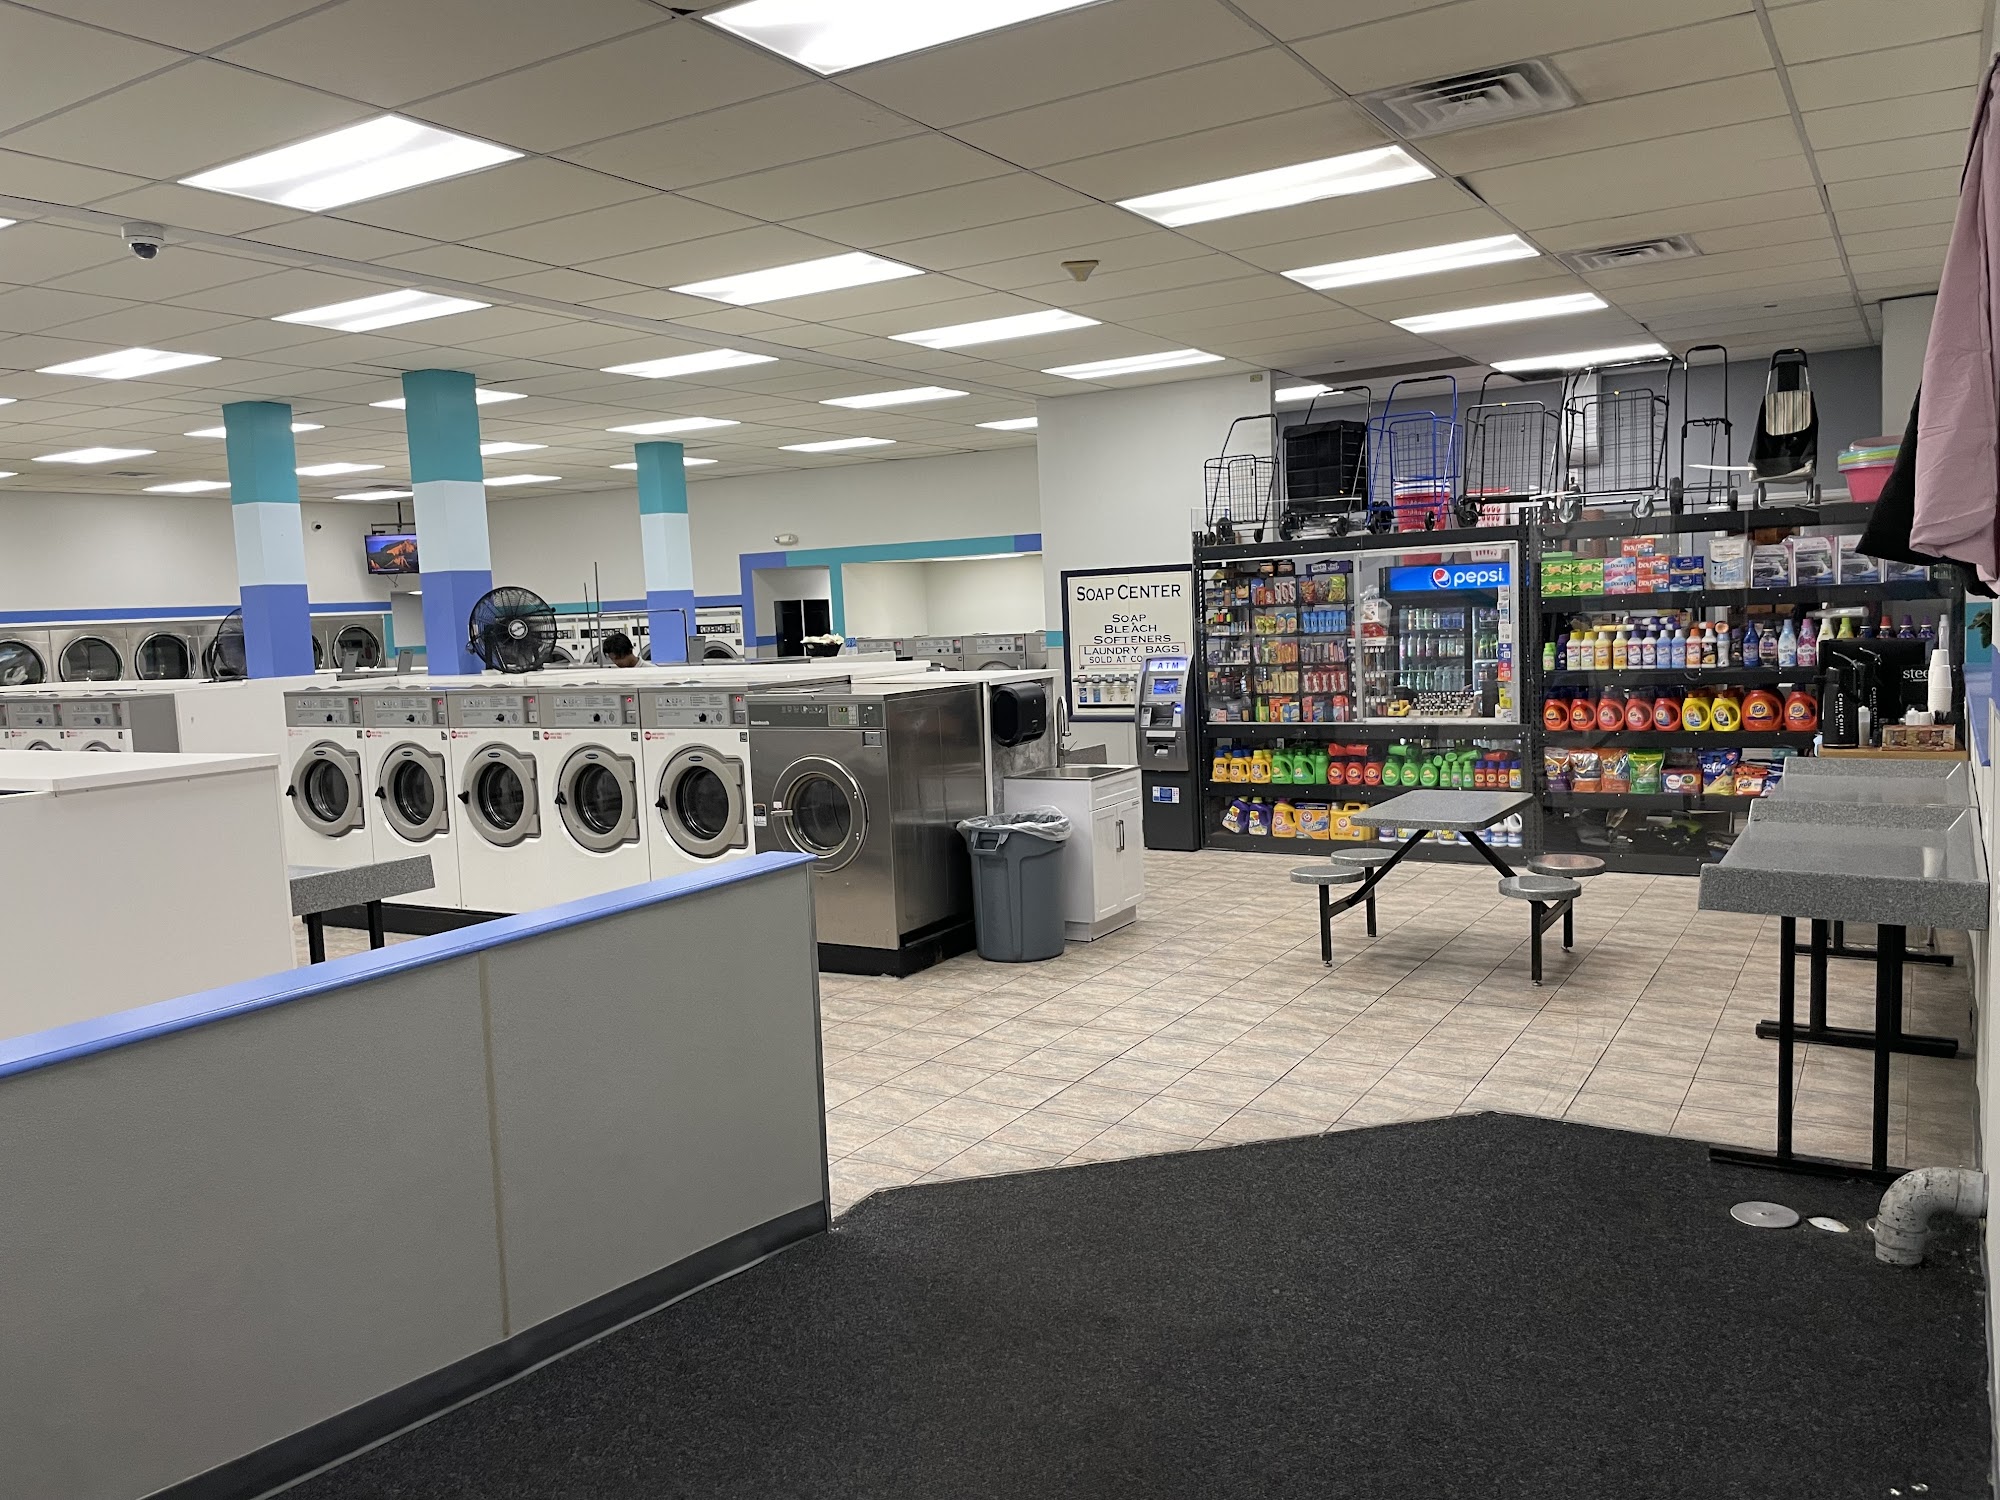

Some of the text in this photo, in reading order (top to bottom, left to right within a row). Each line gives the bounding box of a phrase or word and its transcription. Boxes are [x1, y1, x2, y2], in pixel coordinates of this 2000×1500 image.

[1623, 542, 1649, 551] bounce
[1453, 567, 1503, 587] pepsi
[1077, 584, 1181, 601] SOAP CENTER
[1112, 614, 1147, 623] SOAP
[1104, 624, 1157, 633] BLEACH
[1093, 635, 1172, 644] SOFTENERS
[1083, 645, 1180, 655] LAUNDRY BAGS
[1089, 655, 1143, 664] SOLD AT CO
[1902, 668, 1928, 679] stee
[1751, 704, 1766, 714] Tide
